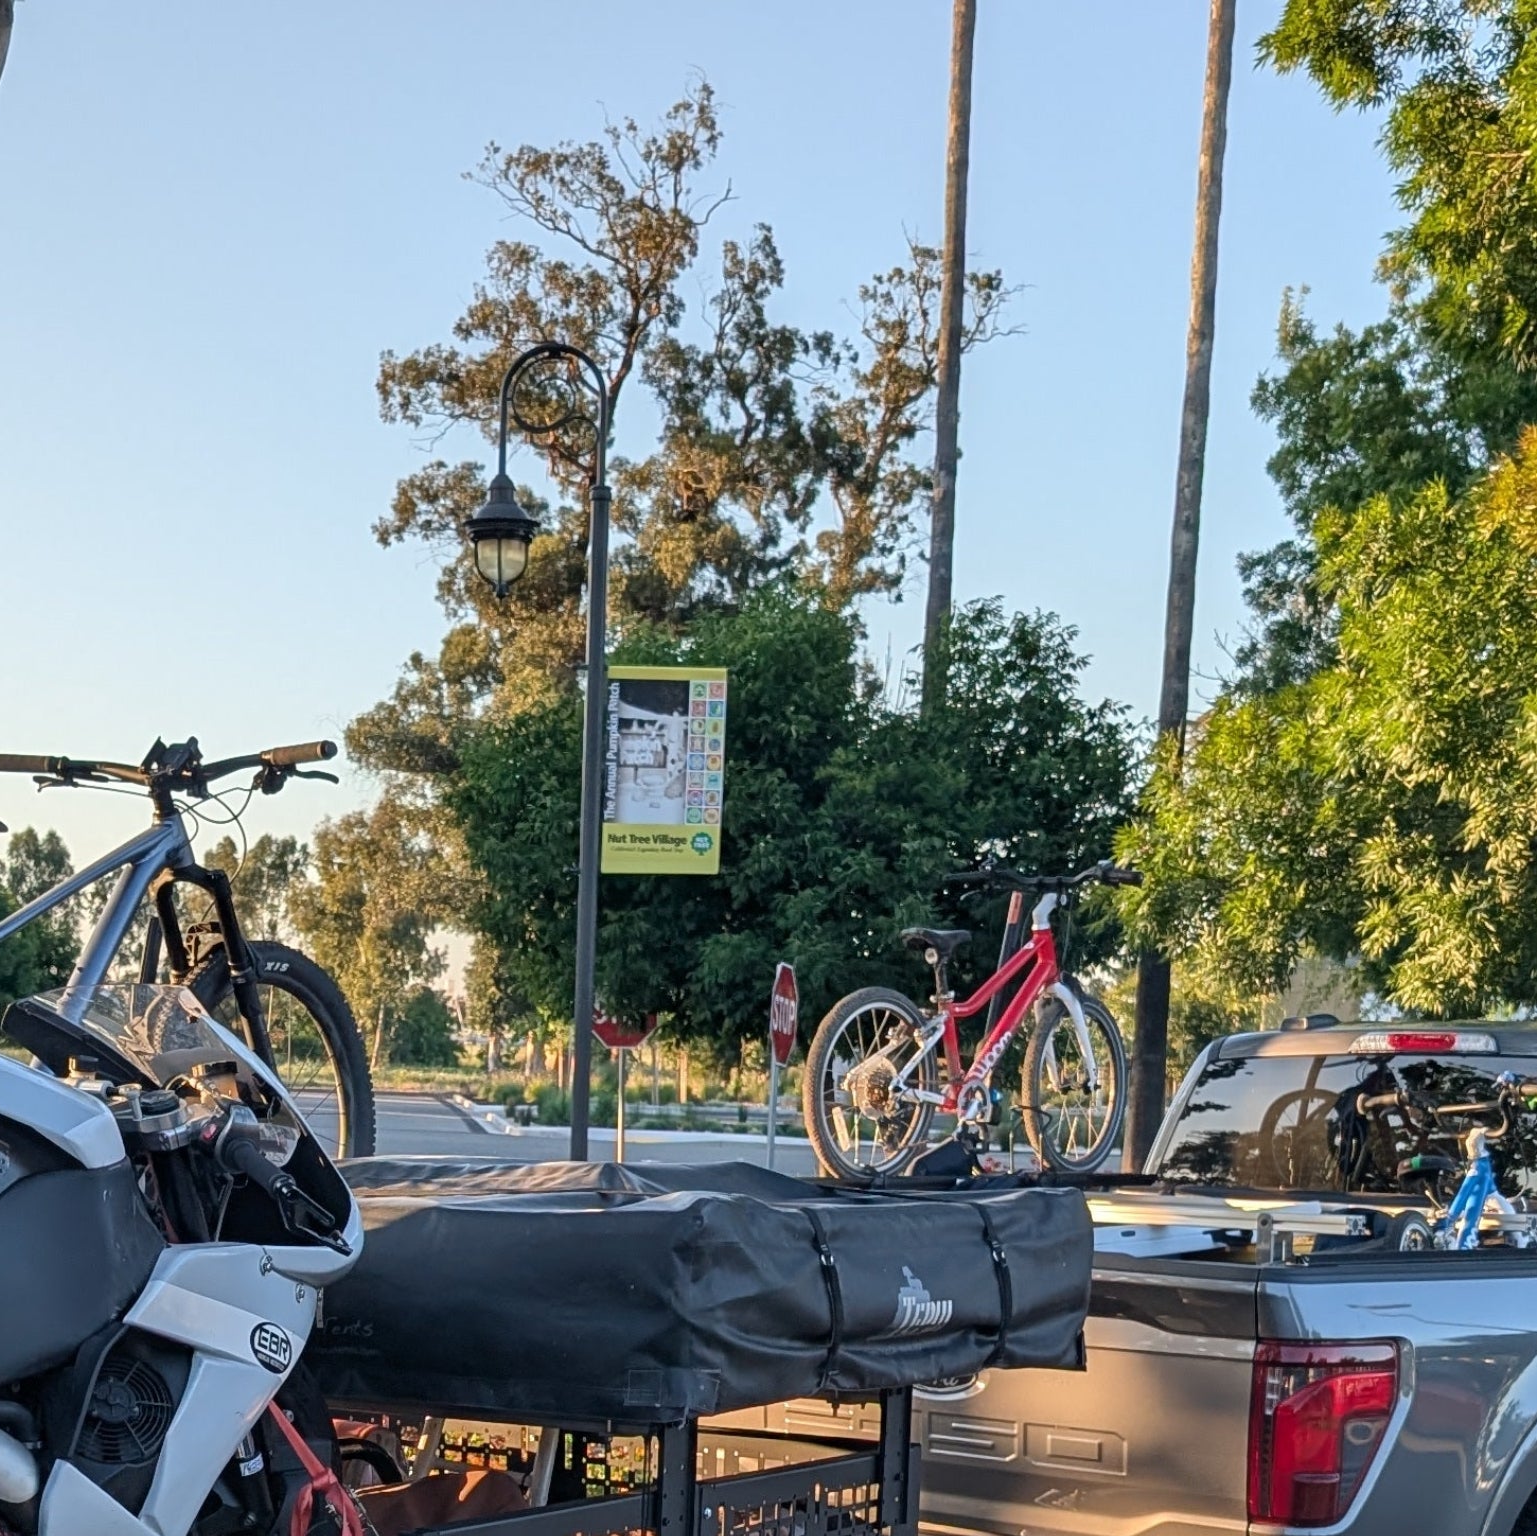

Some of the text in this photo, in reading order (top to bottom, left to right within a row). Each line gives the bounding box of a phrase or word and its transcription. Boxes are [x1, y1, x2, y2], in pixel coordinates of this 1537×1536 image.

[604, 682, 620, 820] The Annual Pumpkin Patch
[607, 833, 688, 847] Nut Tree Village
[264, 961, 289, 973] XIS
[773, 994, 796, 1036] STOP
[257, 1325, 289, 1362] EBR
